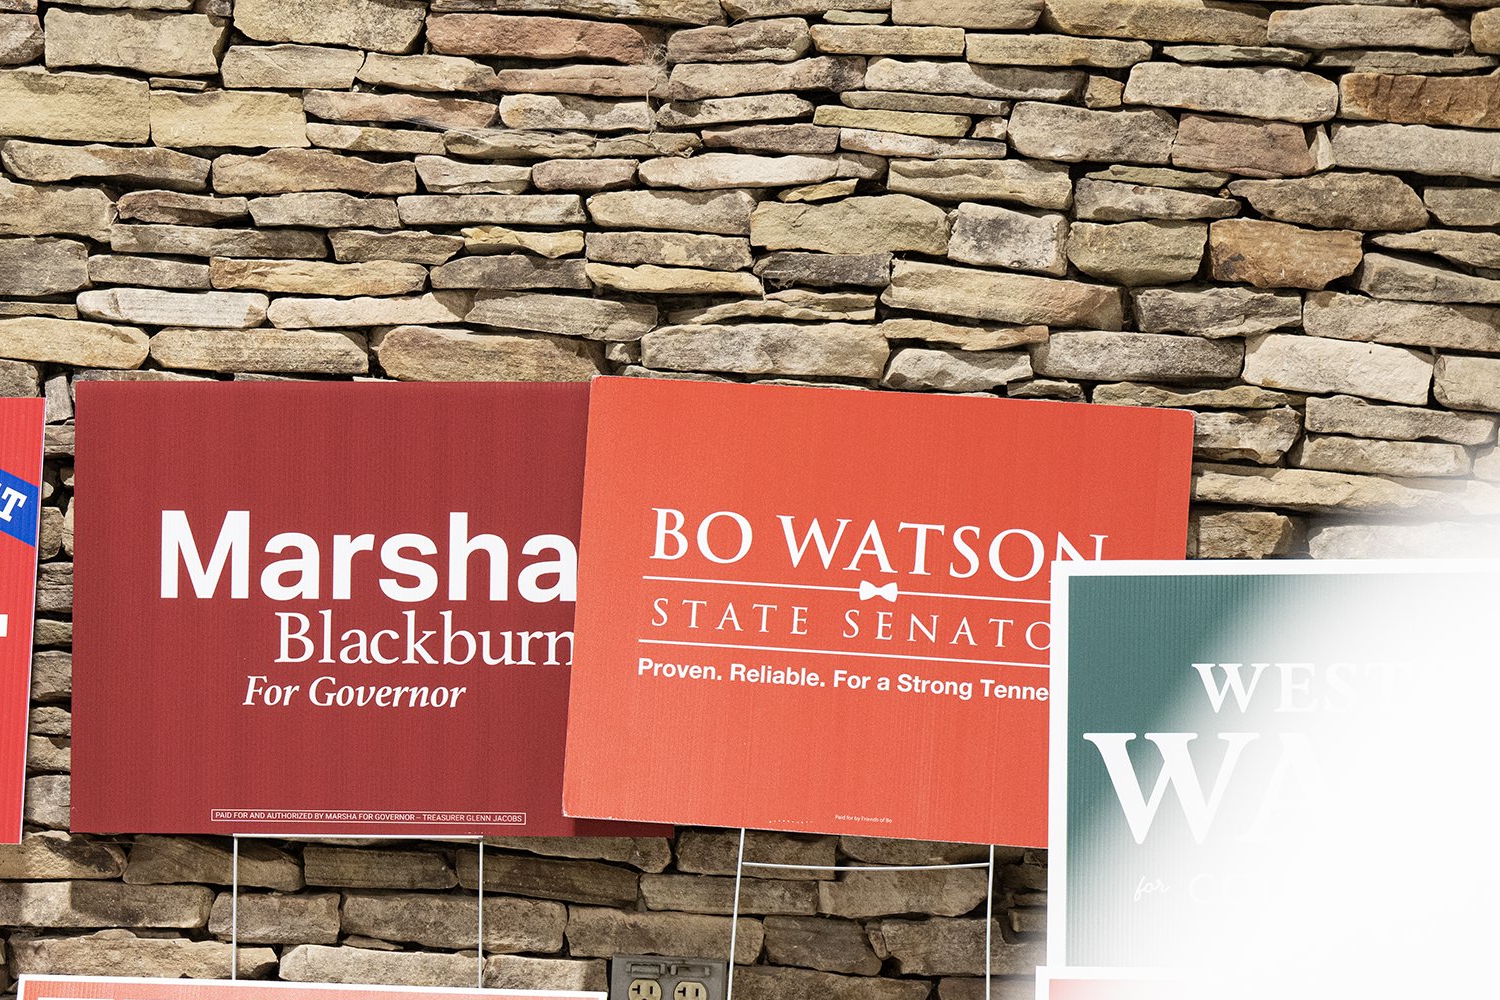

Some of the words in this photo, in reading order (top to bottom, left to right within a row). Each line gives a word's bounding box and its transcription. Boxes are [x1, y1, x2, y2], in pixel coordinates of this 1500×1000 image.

[161, 510, 578, 602] Marsha
[649, 507, 753, 564] BO
[274, 609, 575, 666] Blackburn
[651, 597, 809, 636] STATE
[242, 675, 300, 707] For
[308, 675, 466, 708] Governor
[638, 657, 722, 680] Proven.
[730, 663, 825, 687] Reliable.
[833, 669, 871, 689] For
[877, 676, 890, 691] a
[897, 673, 973, 700] Strong
[266, 812, 313, 820] AUTHORIZED
[374, 813, 415, 821] GOVERNOR
